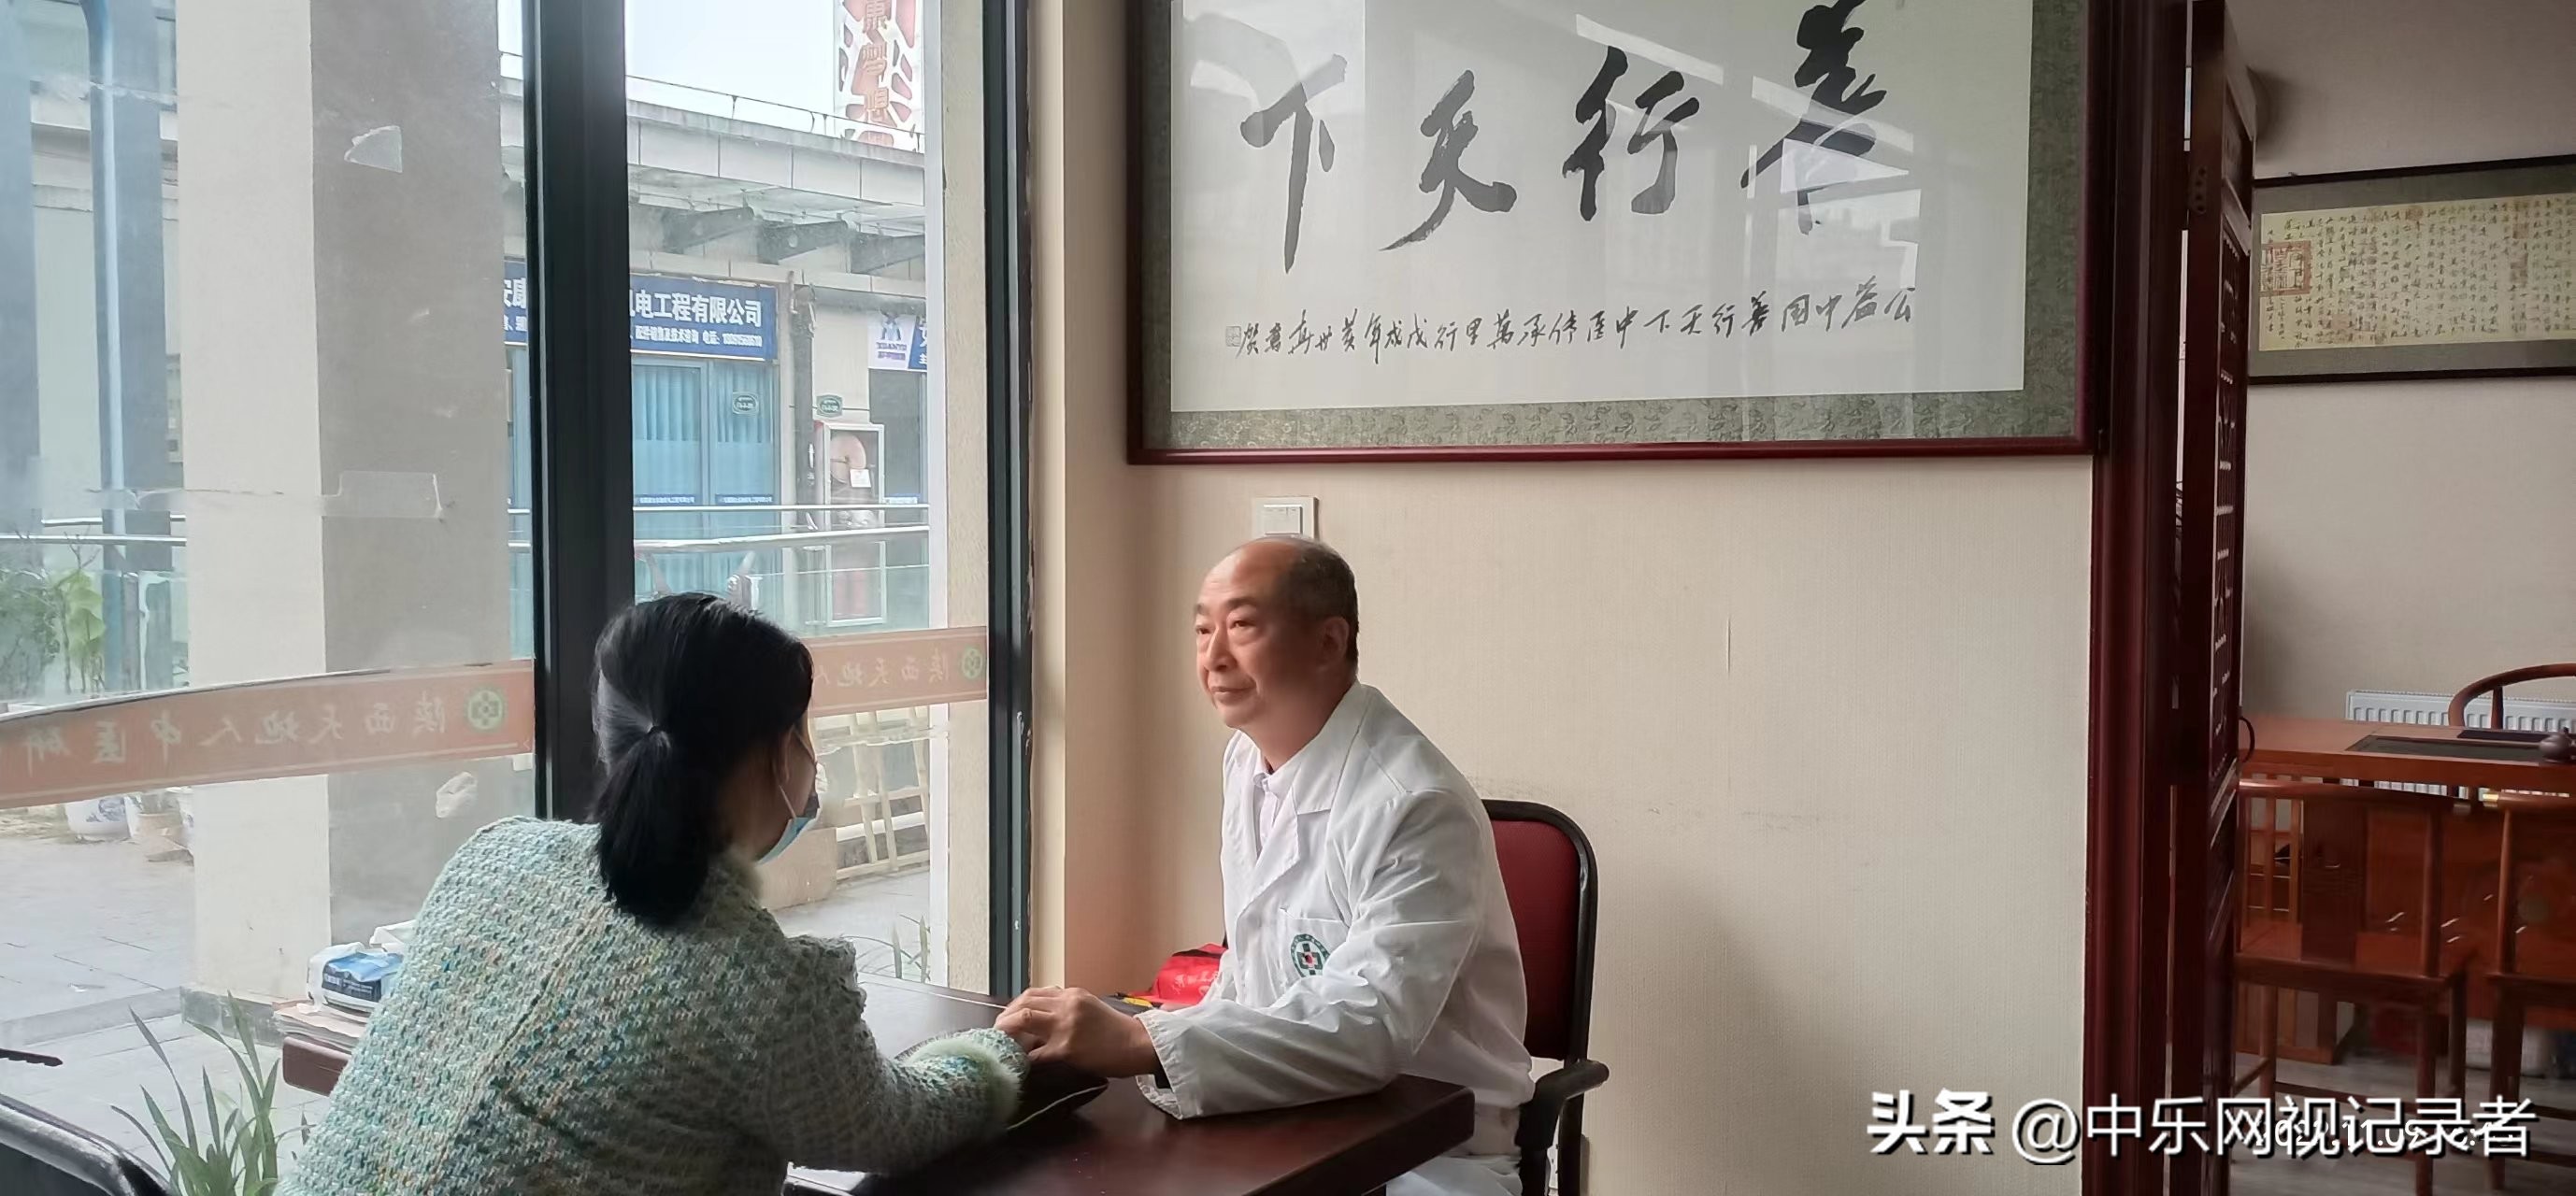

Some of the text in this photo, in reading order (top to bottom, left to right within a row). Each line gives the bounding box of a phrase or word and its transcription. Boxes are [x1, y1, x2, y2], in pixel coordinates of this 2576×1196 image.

[629, 289, 762, 328] 电工程有限公司
